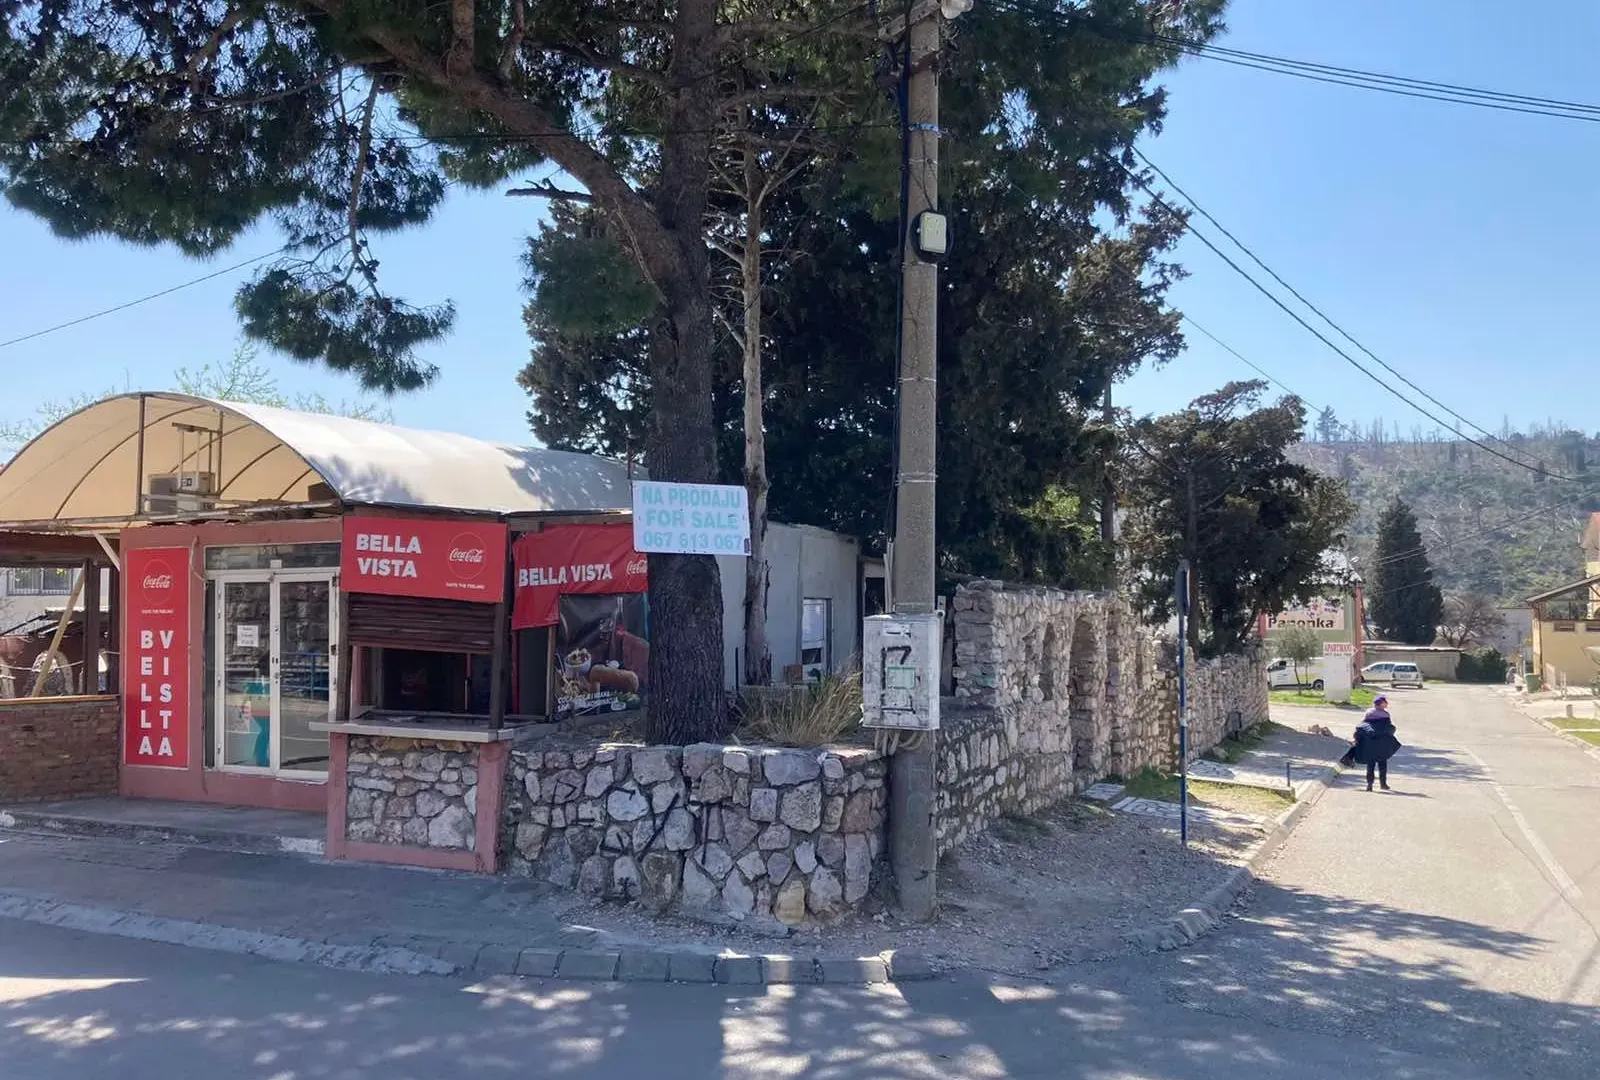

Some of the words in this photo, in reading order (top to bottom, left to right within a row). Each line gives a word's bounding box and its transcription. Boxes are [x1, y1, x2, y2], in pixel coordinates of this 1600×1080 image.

[641, 486, 663, 505] NA
[667, 487, 742, 508] PRODAJU
[646, 509, 685, 528] FOR
[691, 510, 739, 530] SALE
[356, 533, 422, 554] BELLA
[643, 531, 673, 548] 067
[714, 533, 743, 551] 067
[450, 547, 483, 562] Coca-Cola
[357, 556, 418, 578] VISTA
[519, 566, 568, 587] BELLA
[570, 563, 613, 582] VISTA
[626, 559, 648, 575] Coca-Co
[143, 574, 171, 588] Coca-Cola
[138, 629, 153, 755] BELLA
[158, 629, 174, 756] VISTA
